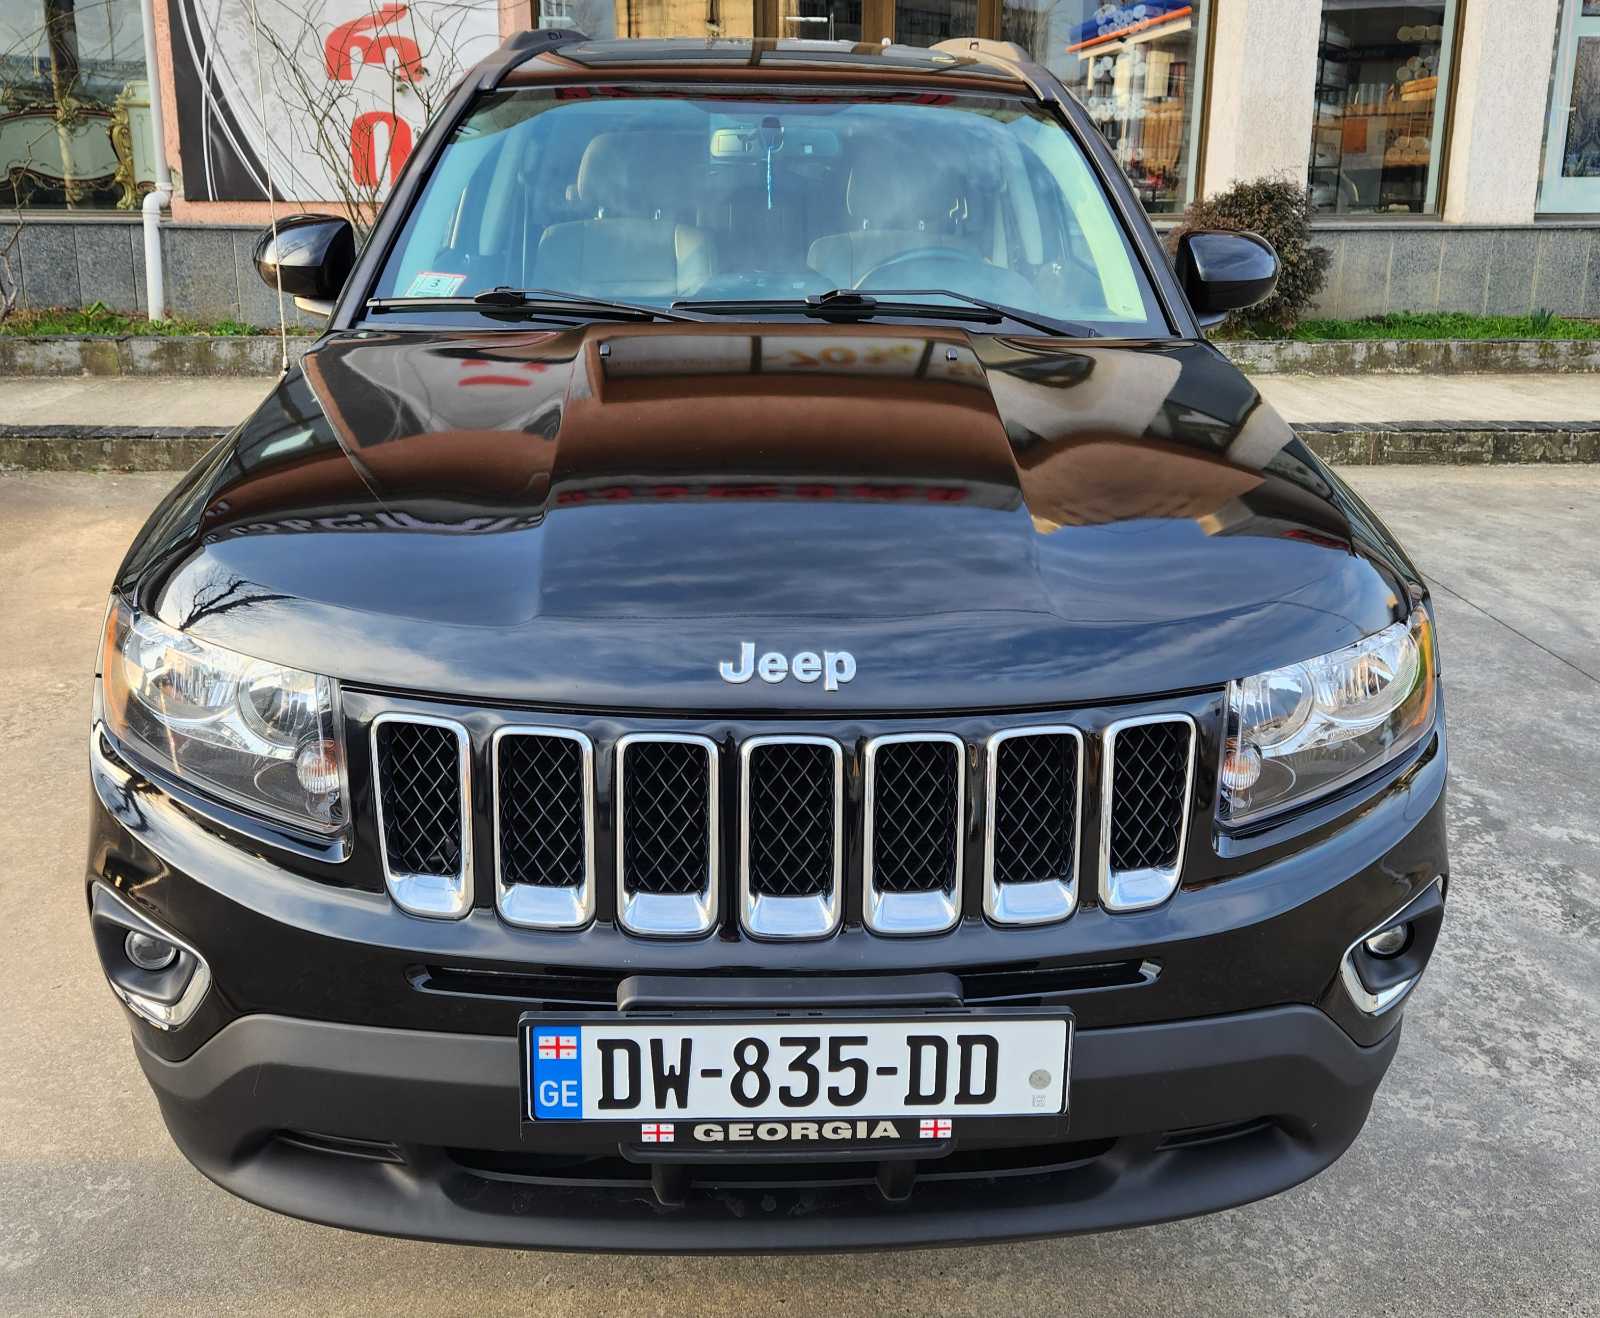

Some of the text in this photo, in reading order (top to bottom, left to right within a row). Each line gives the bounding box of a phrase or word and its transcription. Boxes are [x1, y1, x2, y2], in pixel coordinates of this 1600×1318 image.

[719, 641, 857, 692] Jeep
[596, 1034, 999, 1110] DW-835-DD
[539, 1079, 578, 1108] GE
[693, 1120, 901, 1143] GEORGIA
